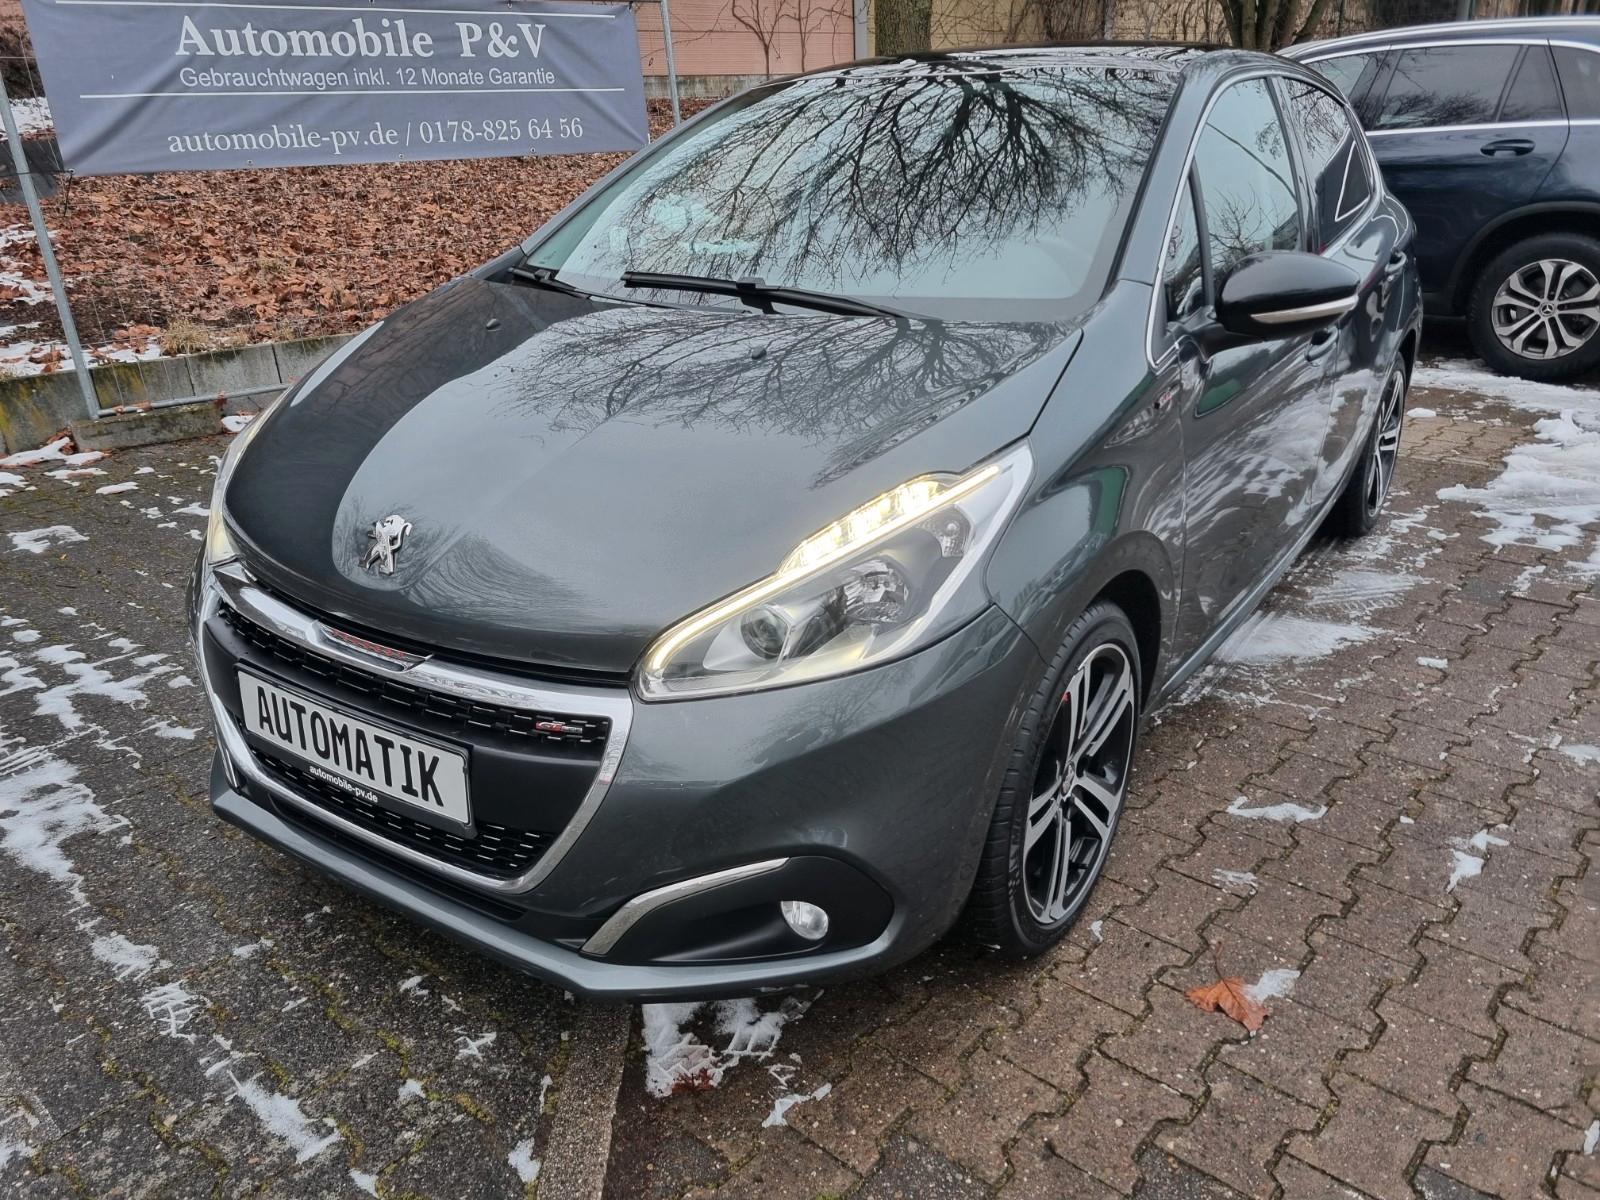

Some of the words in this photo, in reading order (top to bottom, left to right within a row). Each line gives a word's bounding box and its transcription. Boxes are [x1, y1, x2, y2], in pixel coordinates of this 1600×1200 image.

[175, 15, 434, 58] Automobile
[455, 22, 546, 58] P&V
[179, 67, 349, 90] Gebrauchtwagen
[353, 67, 390, 86] inkl.
[396, 69, 417, 86] 12
[422, 68, 484, 85] Monate
[489, 68, 555, 84] Garantie
[167, 122, 399, 154] automobile-pv.de
[419, 119, 521, 144] 0178-825
[528, 118, 553, 140] 64
[559, 117, 583, 138] 56
[256, 685, 444, 807] AUTOMATIK
[309, 765, 378, 803] automobile-pv.de
